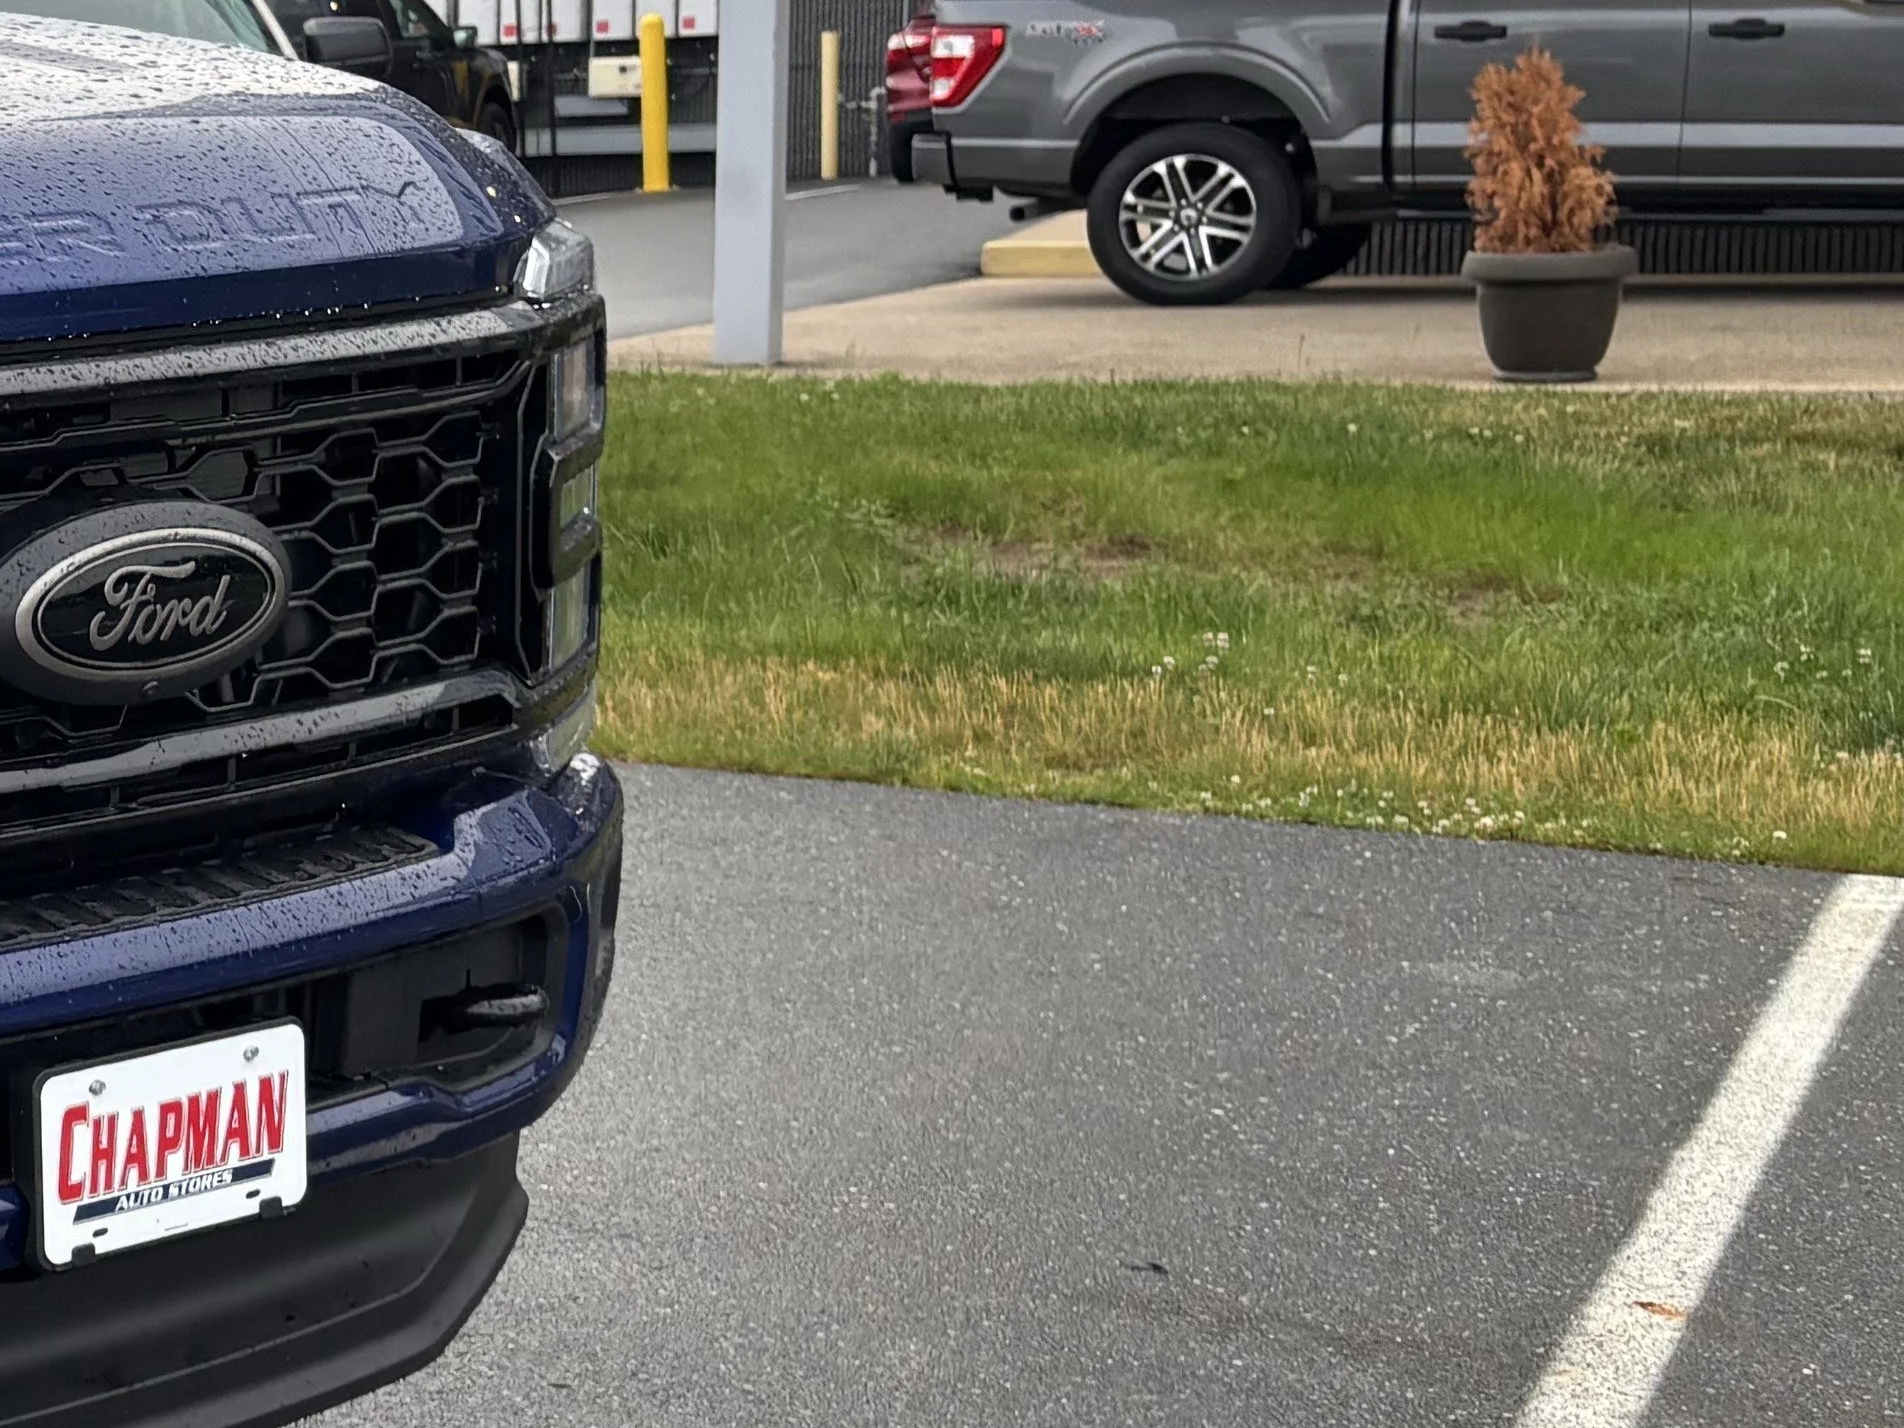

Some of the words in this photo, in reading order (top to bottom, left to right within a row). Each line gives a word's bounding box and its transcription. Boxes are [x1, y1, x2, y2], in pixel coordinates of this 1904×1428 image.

[134, 180, 420, 253] DUTY
[89, 560, 231, 651] Ford
[56, 1069, 289, 1205] CHAPMAN
[114, 1186, 163, 1212] AUTO
[168, 1168, 234, 1198] STORES
